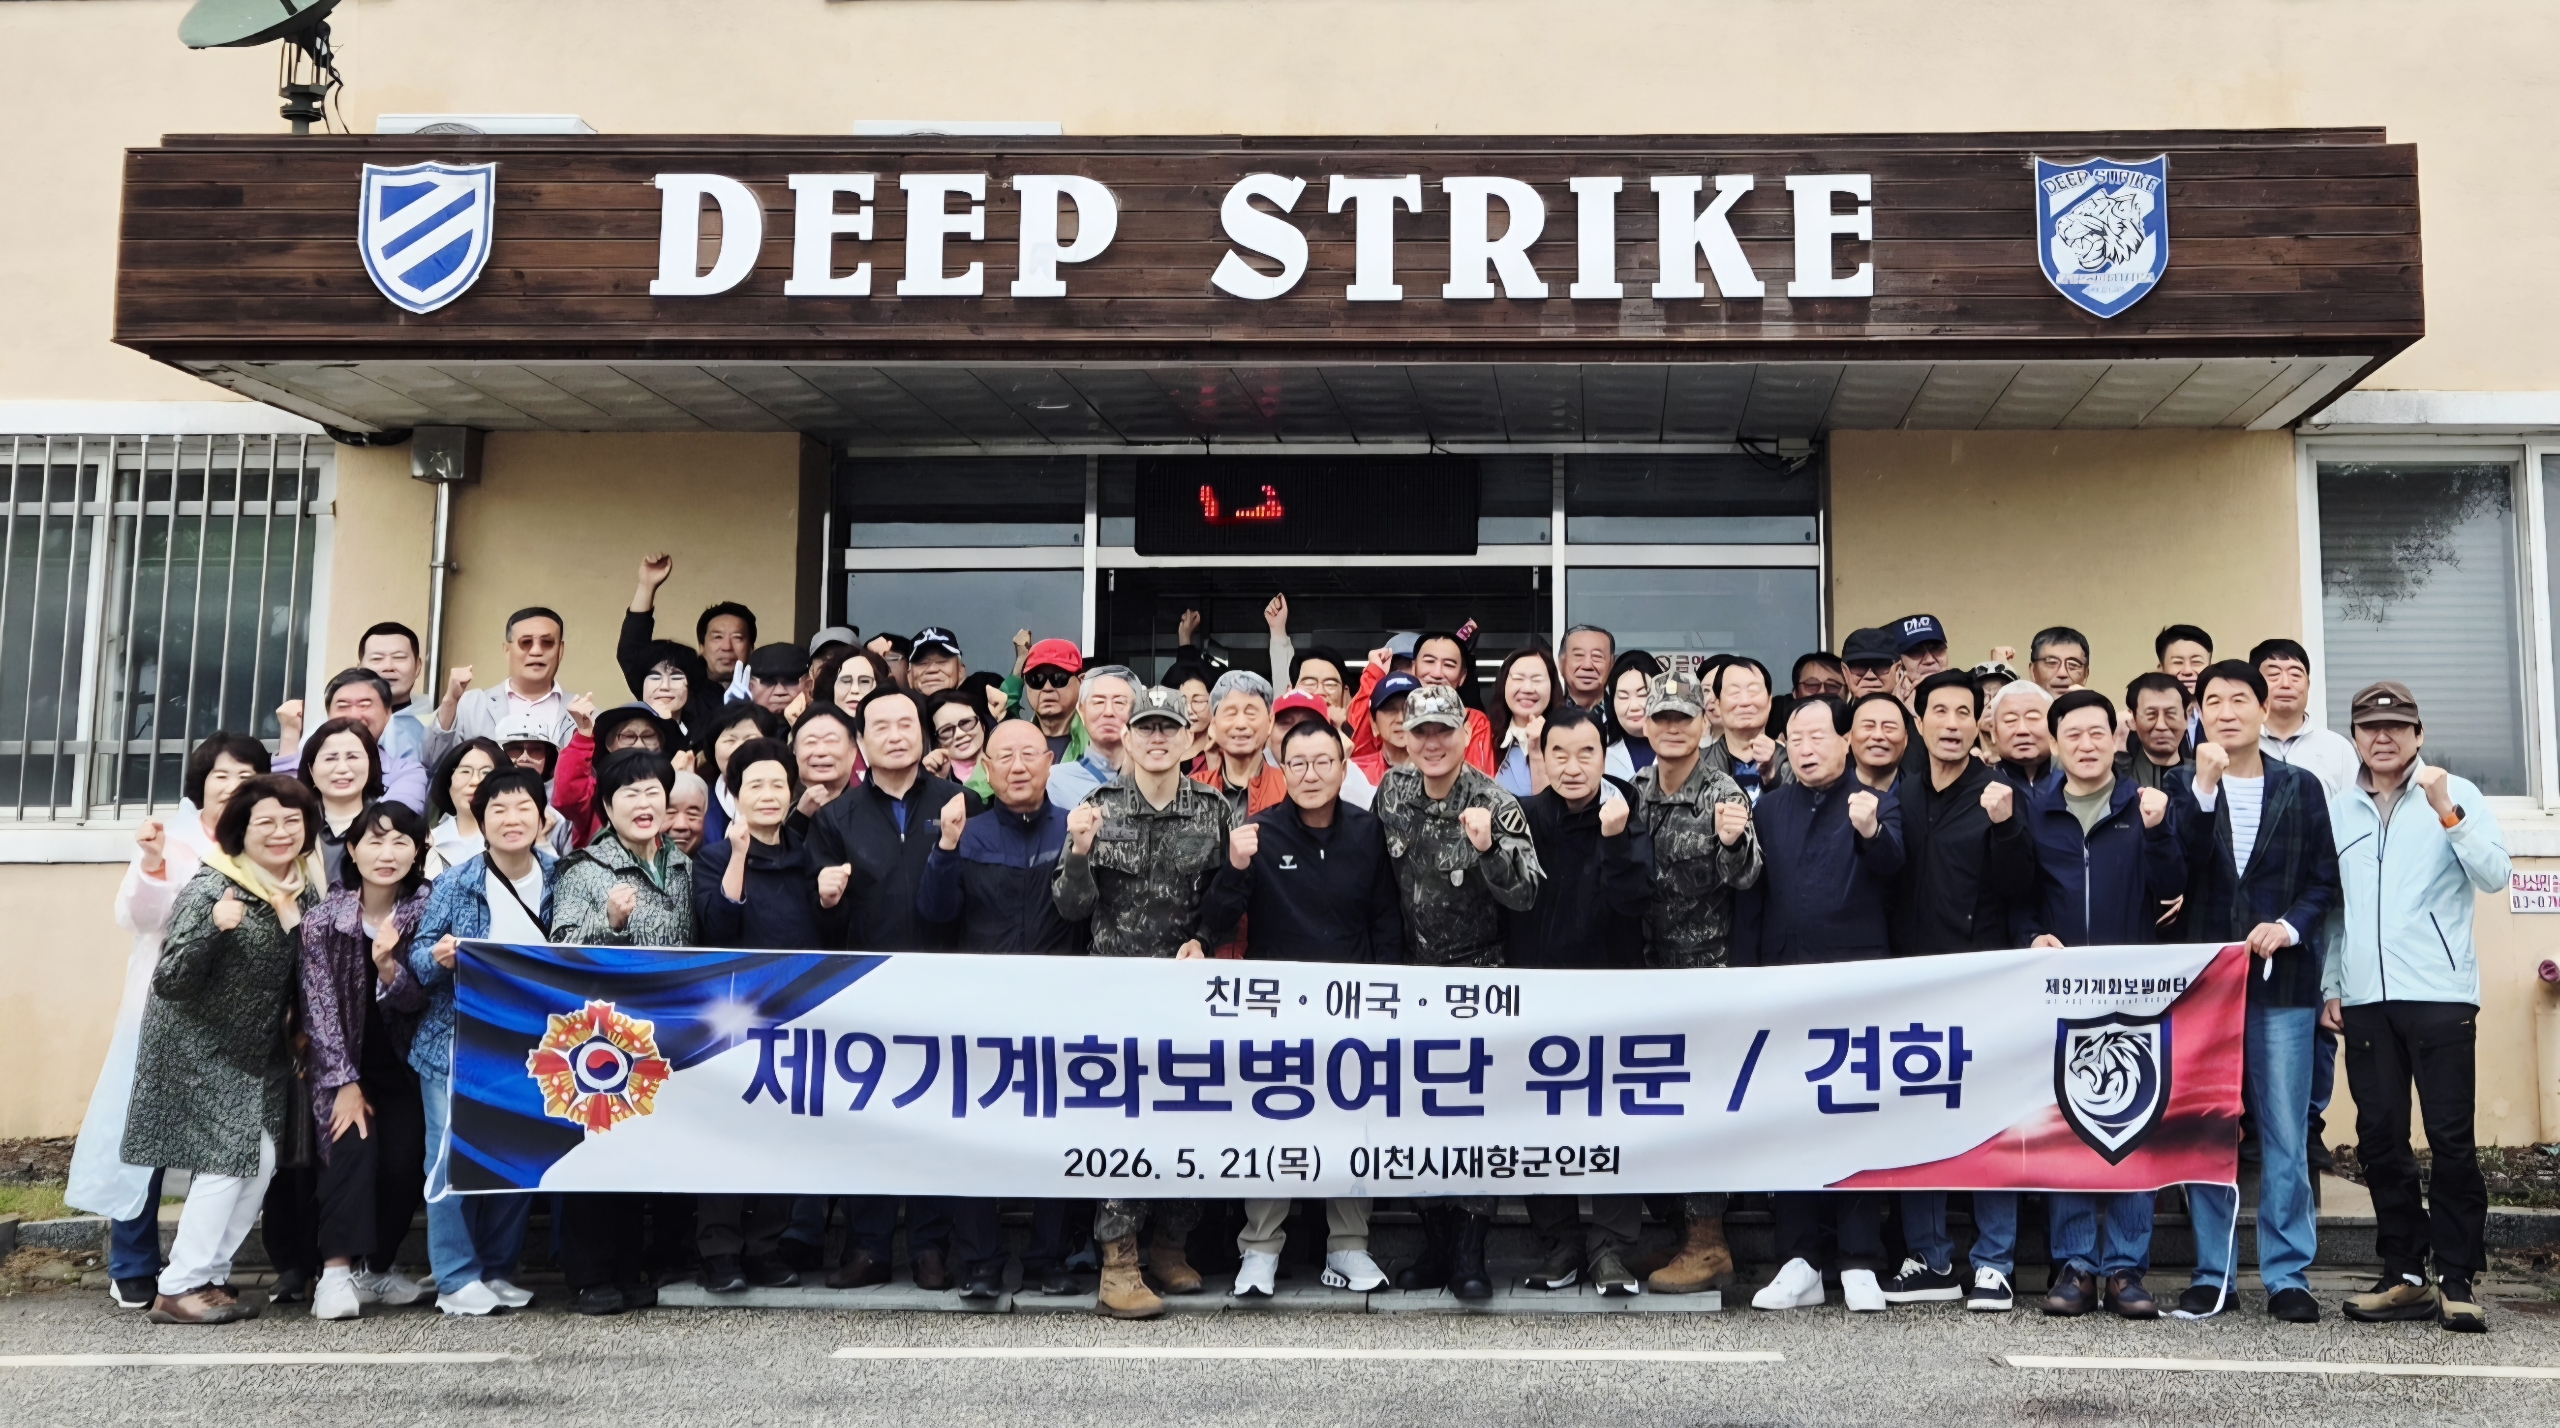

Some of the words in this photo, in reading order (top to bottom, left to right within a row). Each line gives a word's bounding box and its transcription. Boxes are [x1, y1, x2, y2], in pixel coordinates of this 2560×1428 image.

[2042, 171, 2089, 195] DEEP
[648, 173, 1118, 297] DEEP
[1211, 174, 1874, 301] STRIKE
[1205, 976, 1281, 1018] 친목
[1327, 980, 1401, 1020] 애국
[1445, 984, 1521, 1019] 명예
[742, 1027, 1494, 1121] 제9기계화보병여단
[1526, 1034, 1692, 1117] 위문
[1727, 1029, 1770, 1112] /
[1805, 1022, 1974, 1115] 견학
[1064, 1147, 1161, 1181] 2026.
[1177, 1148, 1205, 1181] 5.
[1221, 1145, 1322, 1183] 21(목)
[1350, 1145, 1620, 1181] 이천시재향군인회
